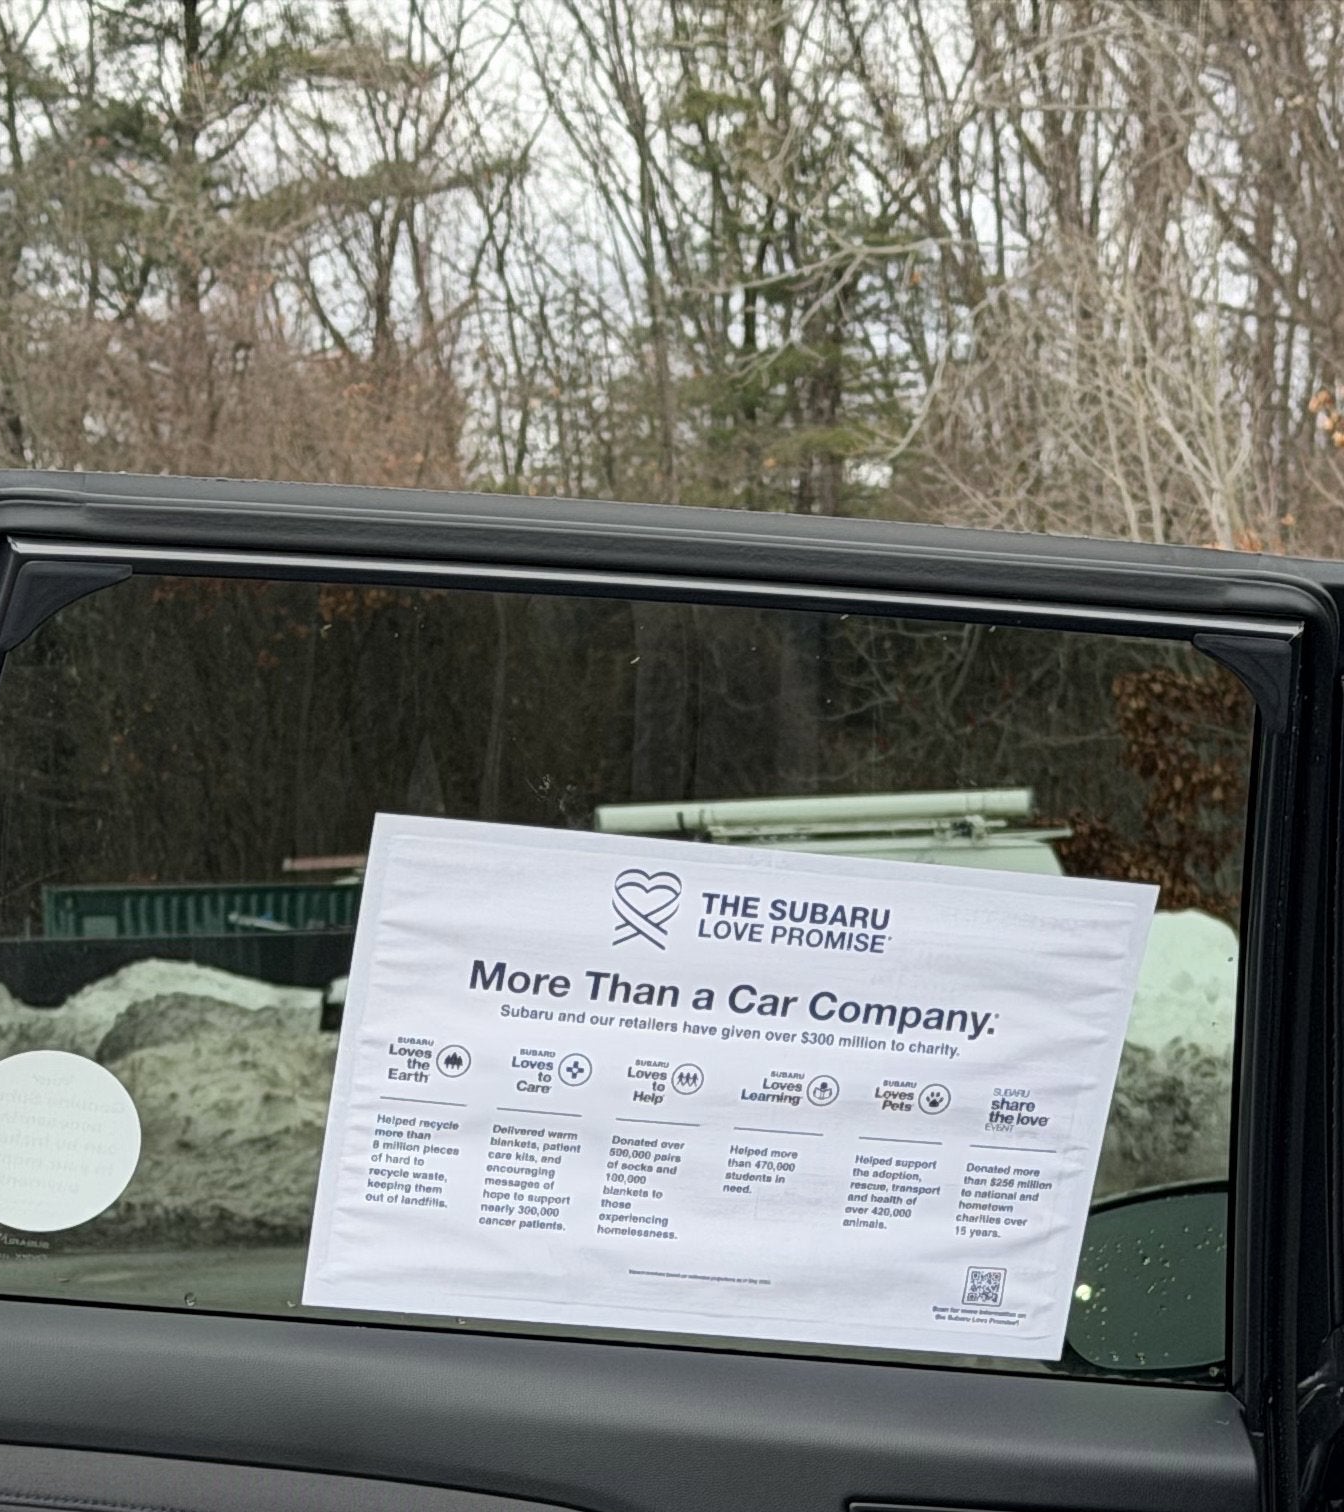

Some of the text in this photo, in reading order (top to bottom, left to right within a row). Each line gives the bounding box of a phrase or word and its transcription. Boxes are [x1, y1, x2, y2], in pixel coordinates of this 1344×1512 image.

[702, 892, 891, 930] THE SUBARU
[698, 919, 886, 953] LOVE PROMISE
[469, 960, 571, 997] More
[585, 971, 683, 1008] Than
[692, 988, 715, 1011] a
[729, 985, 798, 1018] Car
[500, 1004, 960, 1058] Subaru and our retailers have given over $300 million to charity.
[398, 1037, 434, 1046] SUBARU
[389, 1044, 432, 1059] Loves
[520, 1049, 555, 1058] SUBARU
[407, 1059, 430, 1070] the
[512, 1056, 553, 1071] Loves
[635, 1059, 669, 1068] SUBARU
[388, 1068, 429, 1083] Earth
[537, 1072, 551, 1082] to
[627, 1067, 667, 1081] Loves
[771, 1071, 805, 1079] SUBARU
[516, 1081, 551, 1094] Care
[652, 1081, 665, 1092] to
[762, 1078, 802, 1092] Loves
[883, 1080, 917, 1088] SUBARU
[633, 1091, 664, 1105] Help
[741, 1089, 801, 1106] Learning
[875, 1087, 914, 1101] Loves
[993, 1088, 1030, 1098] SUBARU
[882, 1100, 912, 1112] Pets
[991, 1098, 1035, 1112] share
[377, 1114, 459, 1131] Helped recycle
[988, 1111, 1048, 1126] the love
[375, 1128, 431, 1140] more than
[492, 1125, 578, 1140] Delivered warm
[984, 1123, 1014, 1133] EVENT
[383, 1141, 420, 1153] million
[423, 1144, 459, 1156] pieces
[490, 1137, 580, 1153] blankets, patient
[612, 1135, 685, 1150] Donated over
[488, 1150, 561, 1164] care kits, and
[609, 1148, 681, 1163] 500,000 pairs
[730, 1145, 798, 1159] Helped more
[371, 1153, 424, 1166] of hard to
[728, 1158, 795, 1172] than 470,000
[855, 1155, 937, 1170] Helped support
[369, 1167, 448, 1182] recycle waste,
[486, 1164, 555, 1179] encouraging
[607, 1161, 677, 1175] of socks and
[853, 1168, 922, 1182] the adoption,
[966, 1163, 1040, 1177] Donated more
[485, 1177, 555, 1190] messages of
[606, 1172, 646, 1185] 100,000
[725, 1171, 785, 1184] students in
[964, 1176, 987, 1186] than
[1017, 1179, 1052, 1190] million
[367, 1179, 442, 1194] keeping them
[603, 1185, 663, 1199] blankets to
[723, 1183, 752, 1194] need.
[850, 1182, 940, 1197] rescue, transport
[366, 1193, 448, 1208] out of landfills.
[483, 1190, 570, 1207] hope to support
[848, 1193, 917, 1206] and health of
[961, 1188, 1039, 1202] to national and
[481, 1203, 559, 1218] nearly 300,000
[601, 1198, 631, 1209] those
[958, 1201, 1013, 1212] hometown
[845, 1206, 912, 1218] over 420,000
[479, 1216, 565, 1231] cancer patients.
[599, 1213, 668, 1227] experiencing
[843, 1218, 887, 1230] animals.
[956, 1213, 1027, 1227] charities over
[597, 1225, 678, 1239] homelessness.
[955, 1226, 1001, 1239] 15 years.
